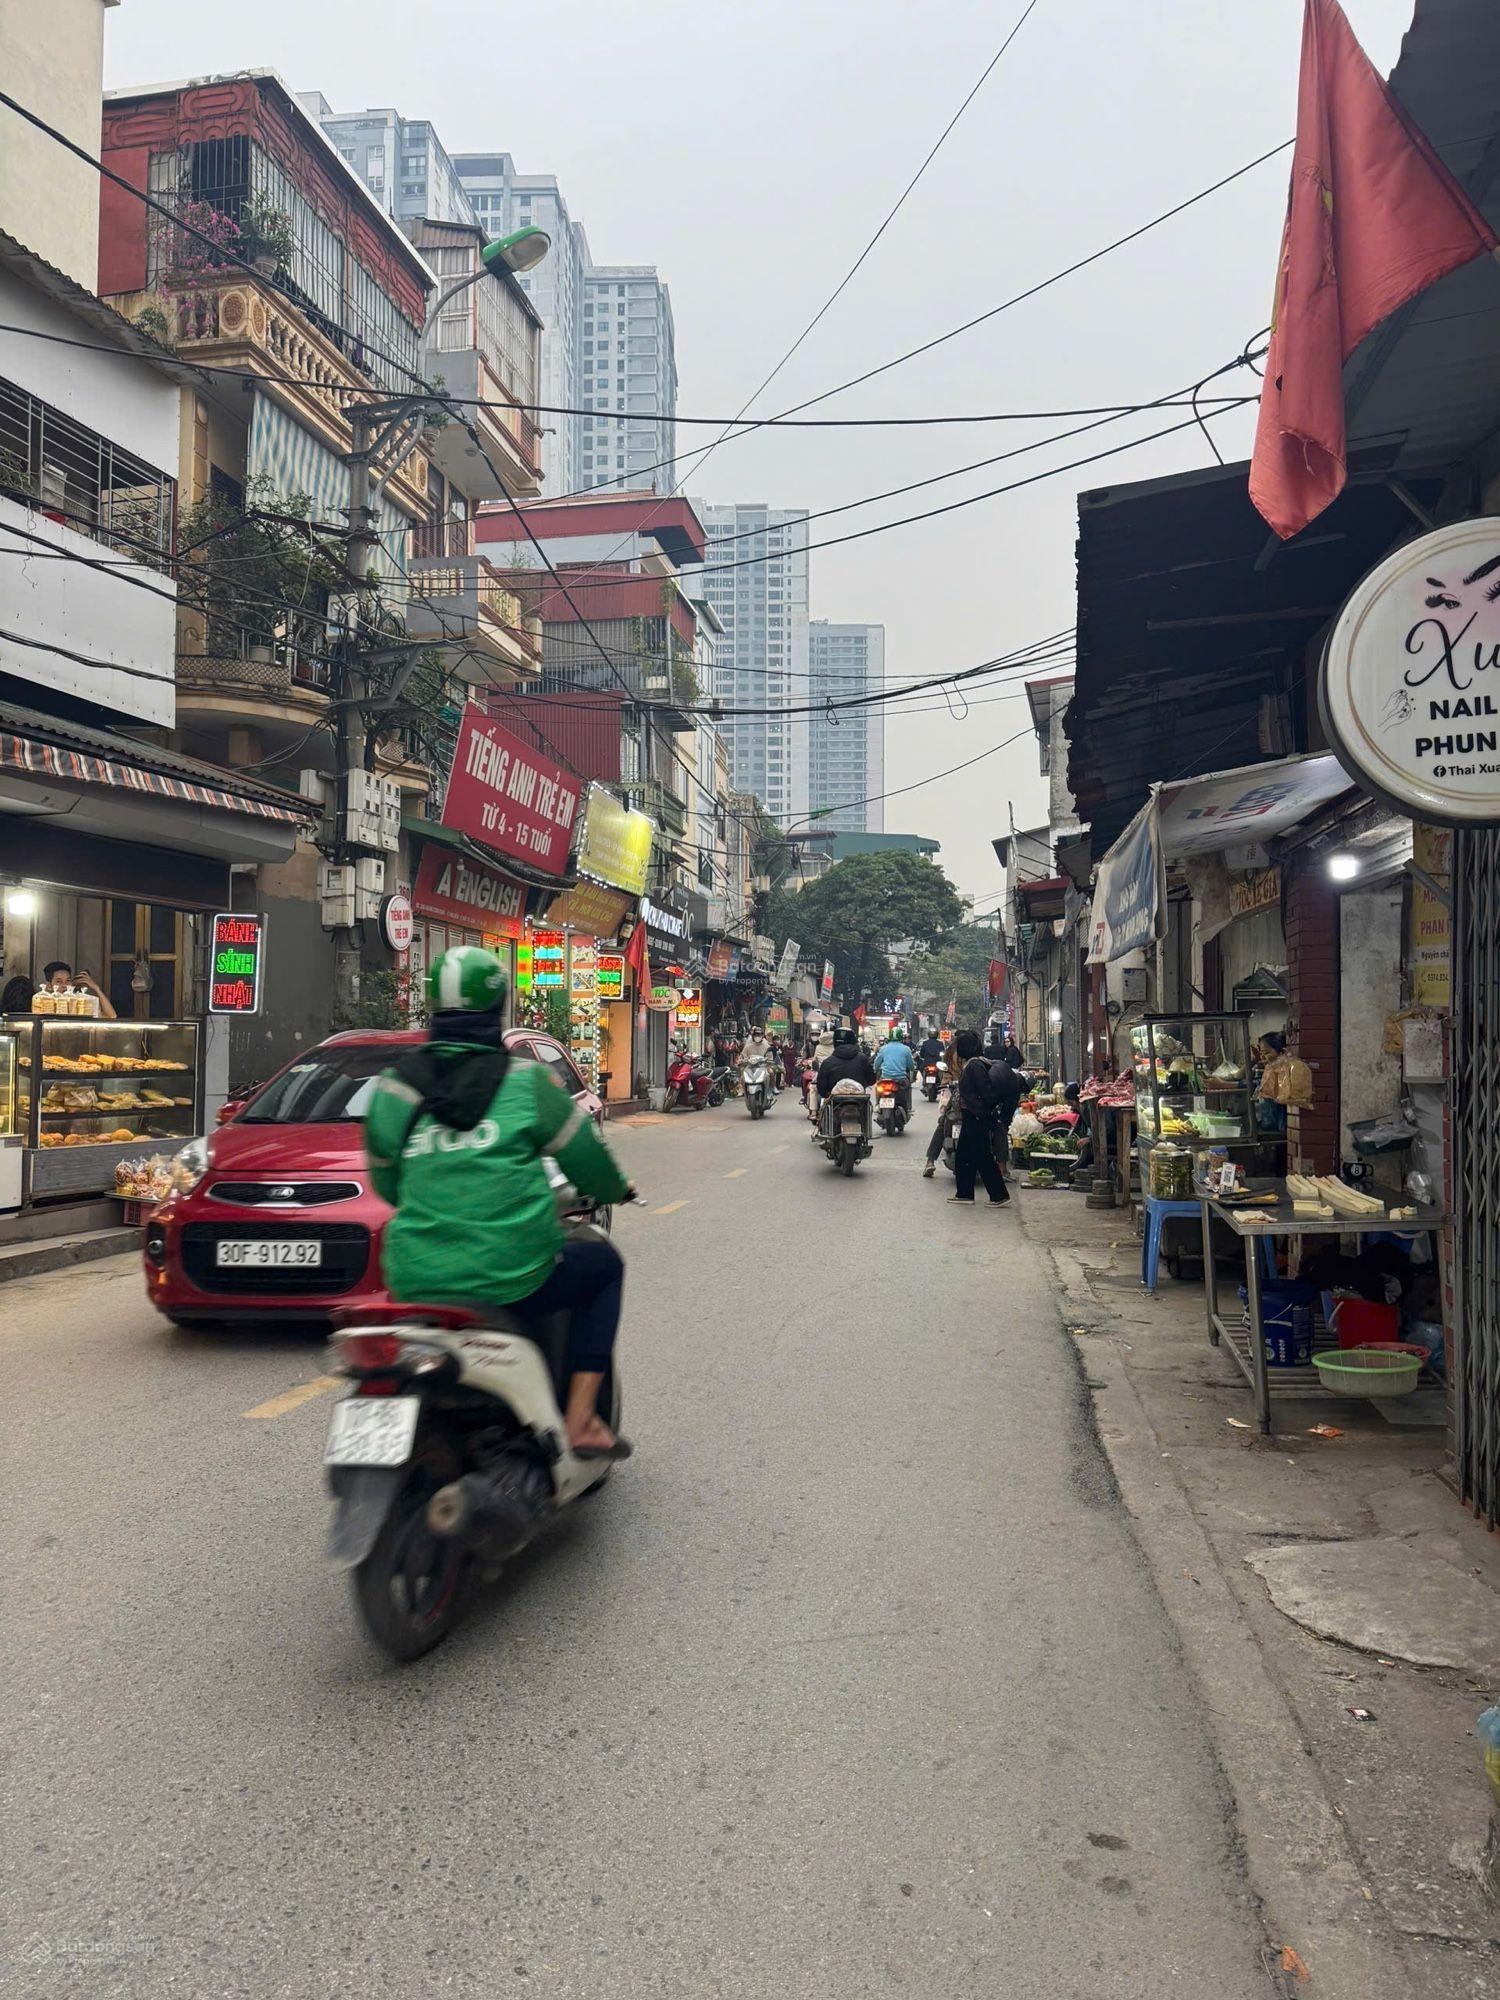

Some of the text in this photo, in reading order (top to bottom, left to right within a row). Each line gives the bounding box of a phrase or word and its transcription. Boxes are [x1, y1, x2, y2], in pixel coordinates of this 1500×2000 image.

[1429, 695, 1498, 720] NAIL
[1415, 731, 1497, 757] PHUN
[465, 727, 577, 830] TIẾNG ANH TRẺ EM
[1448, 764, 1475, 776] Thai
[481, 802, 500, 831] TỪ
[498, 812, 507, 836] 4
[515, 822, 530, 847] 15
[529, 827, 553, 857] TUỔI
[455, 868, 522, 919] ENGLISH
[390, 906, 402, 921] TIẾNG
[216, 918, 258, 943] BÁNH
[213, 979, 253, 1009] NHẬT
[219, 1243, 318, 1264] 30F-912.92
